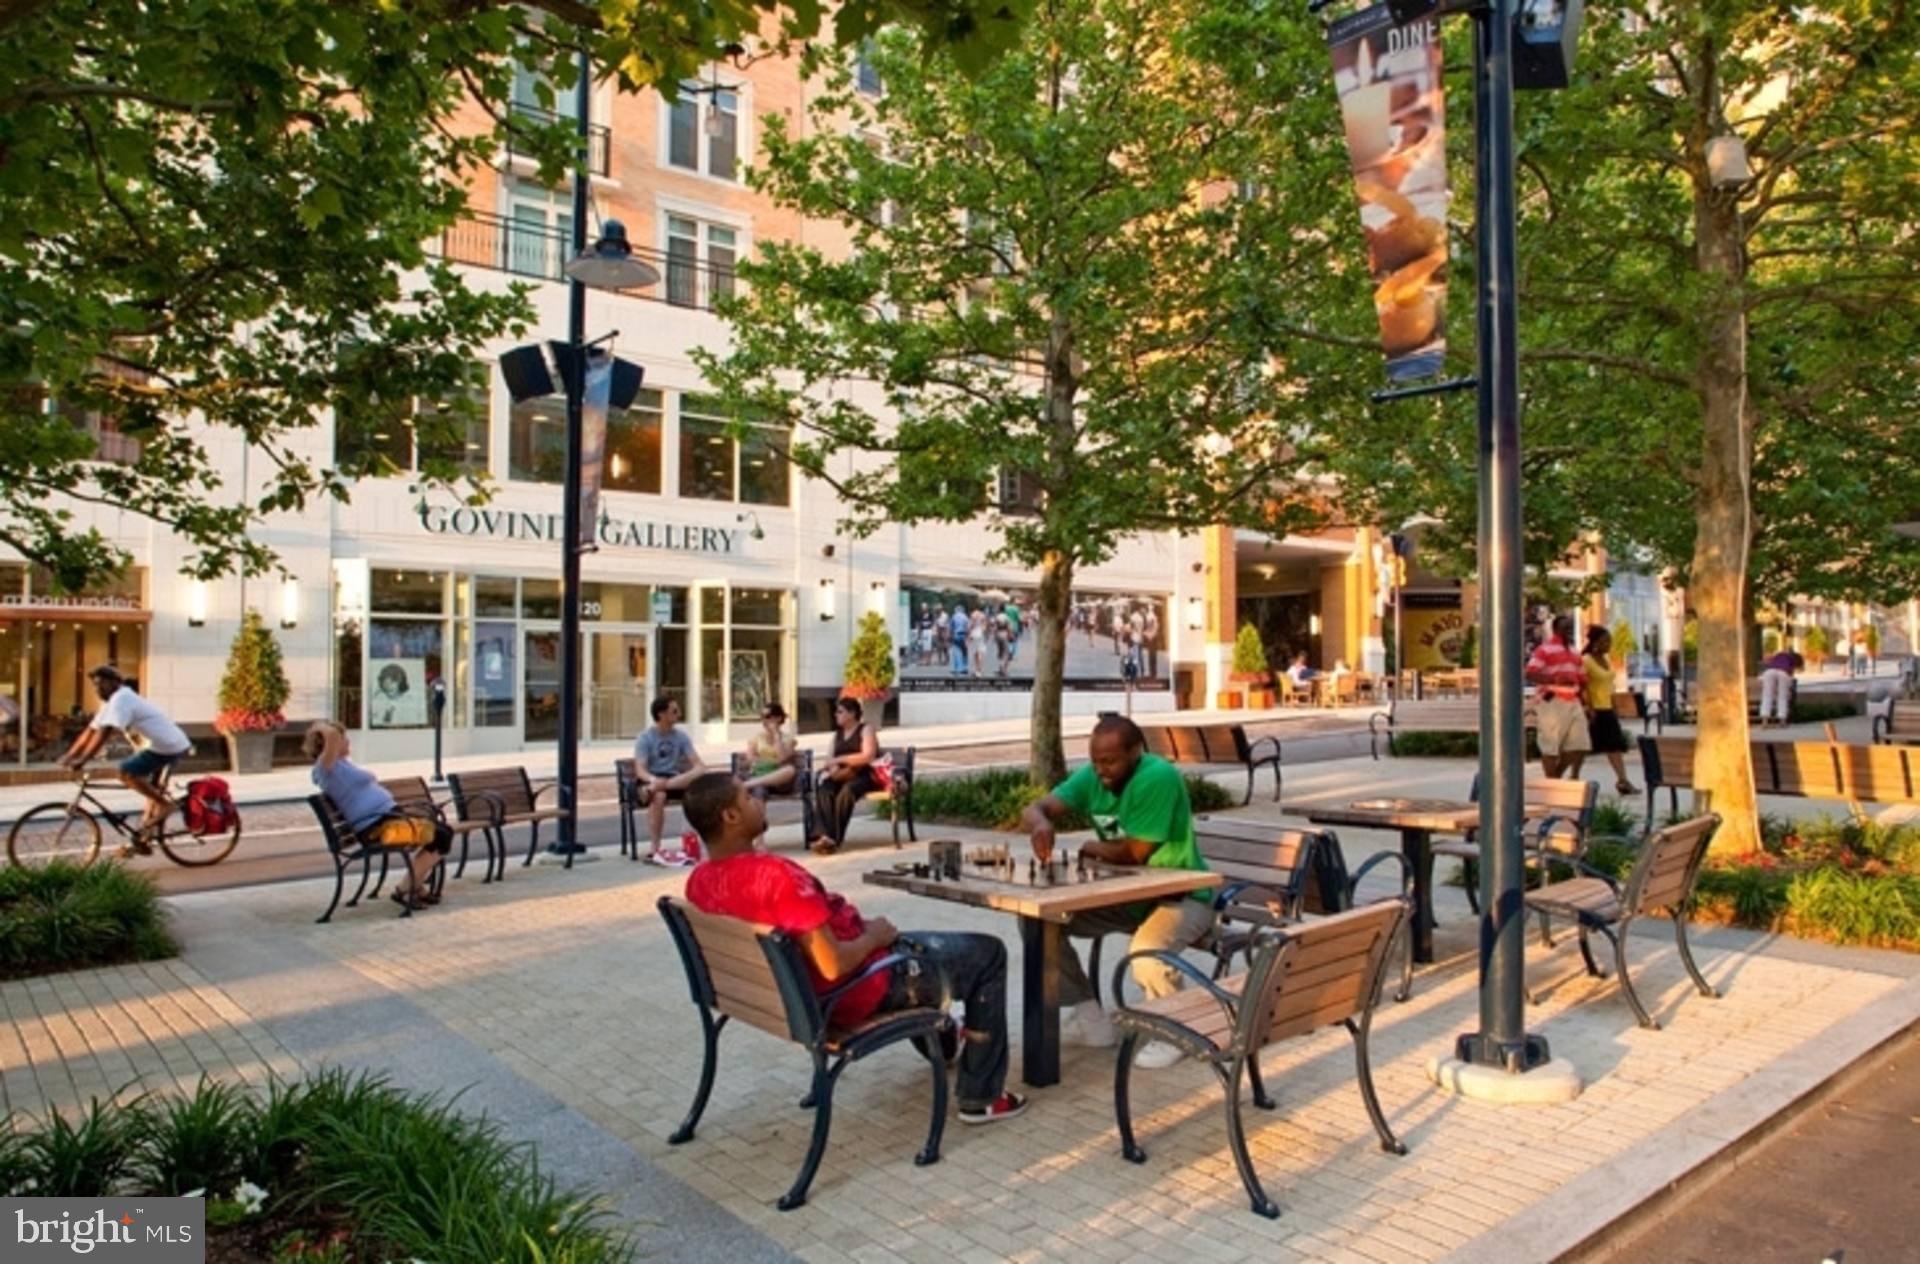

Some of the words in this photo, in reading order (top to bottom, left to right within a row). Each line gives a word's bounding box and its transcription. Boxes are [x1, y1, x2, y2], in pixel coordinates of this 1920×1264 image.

[1387, 20, 1438, 55] DINE
[600, 519, 736, 552] GALLERY
[580, 601, 601, 615] 20
